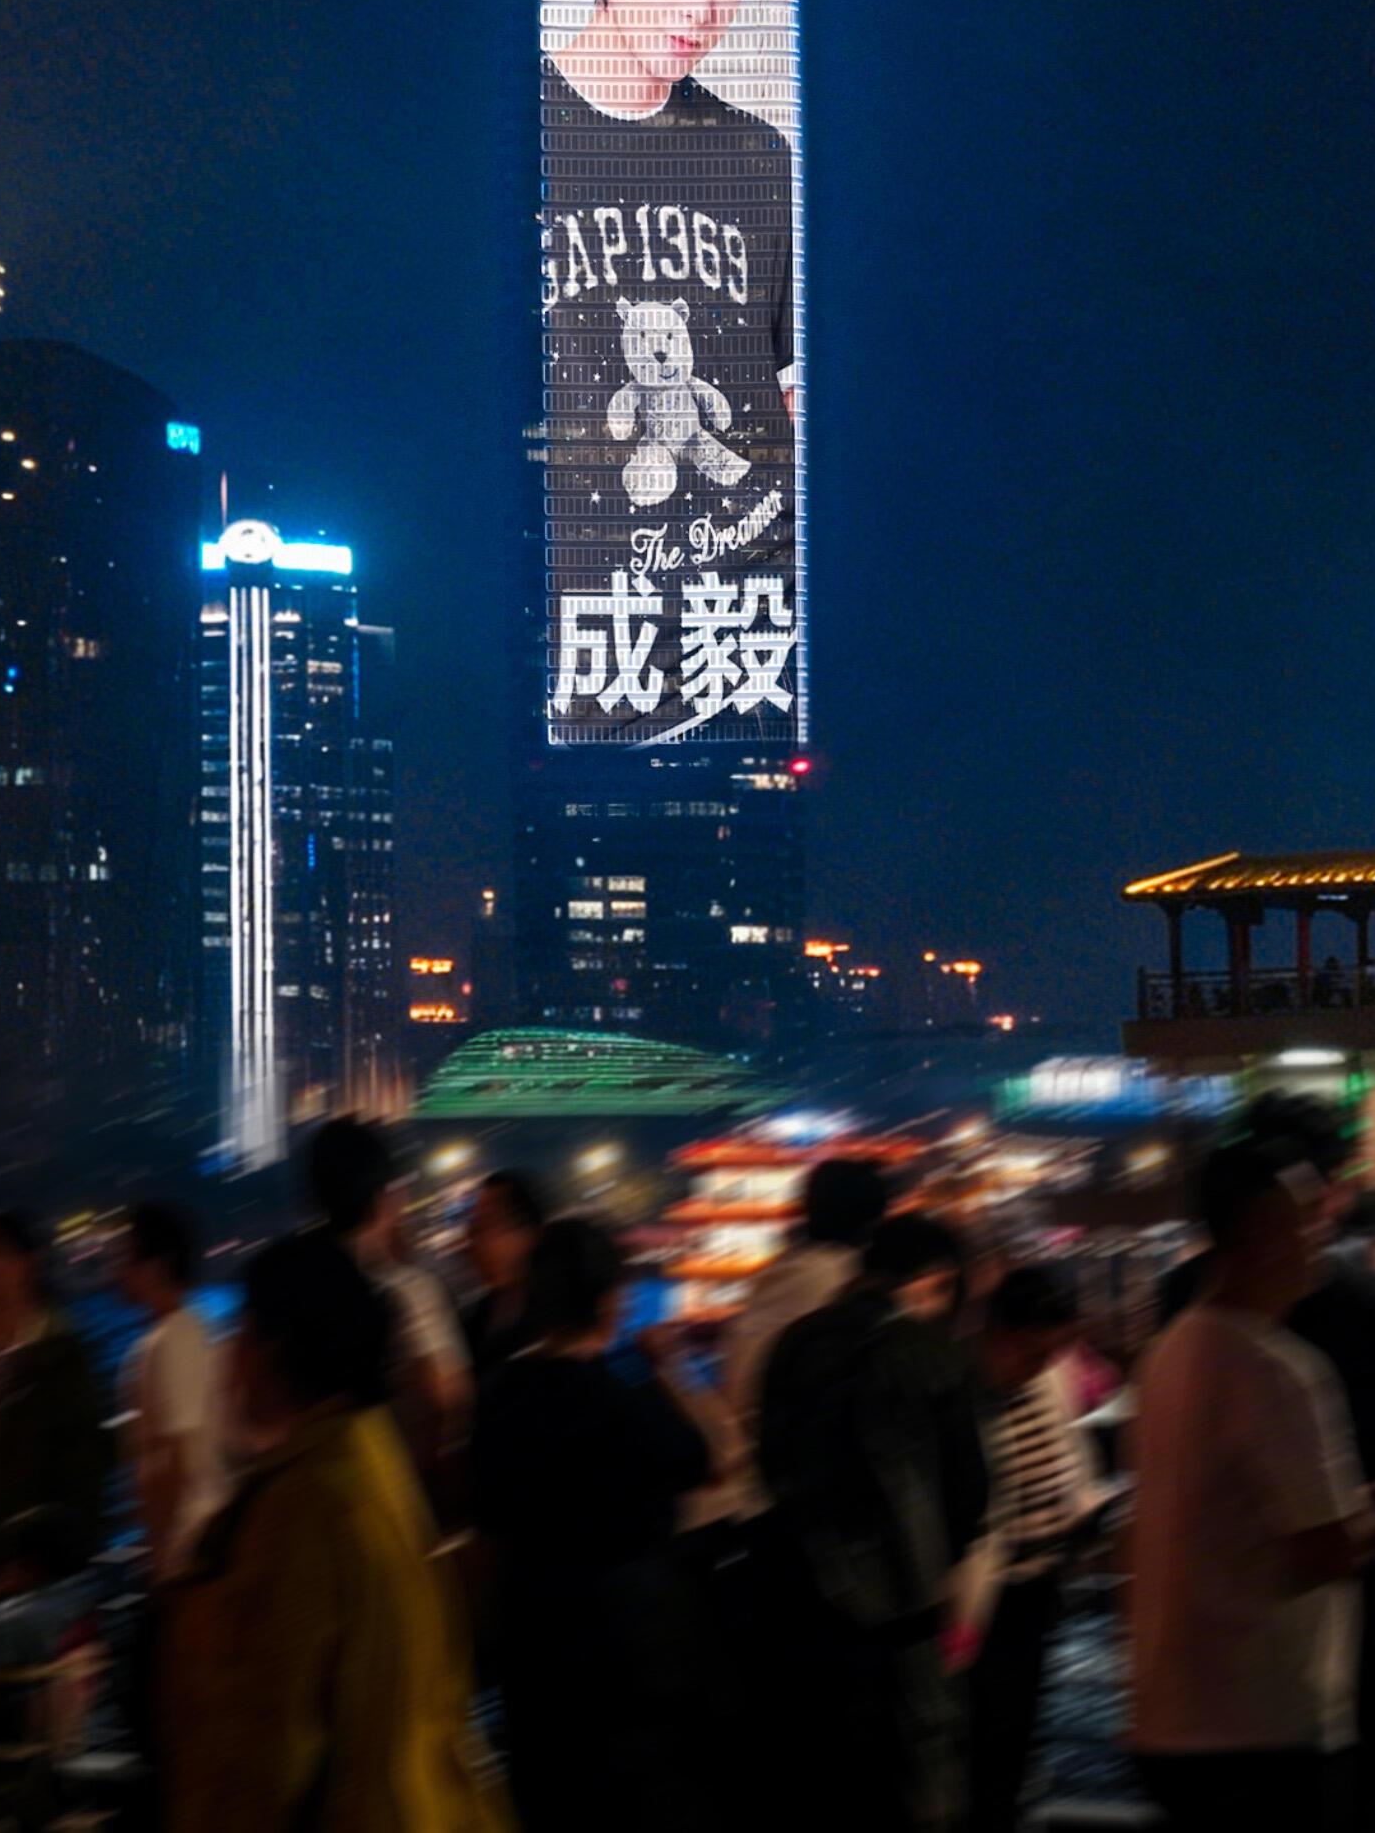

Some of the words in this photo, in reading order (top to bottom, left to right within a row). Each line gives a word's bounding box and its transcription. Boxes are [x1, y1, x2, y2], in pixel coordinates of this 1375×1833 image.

[630, 523, 685, 575] The
[689, 490, 783, 564] Dreamer
[552, 570, 793, 716] 成毅
